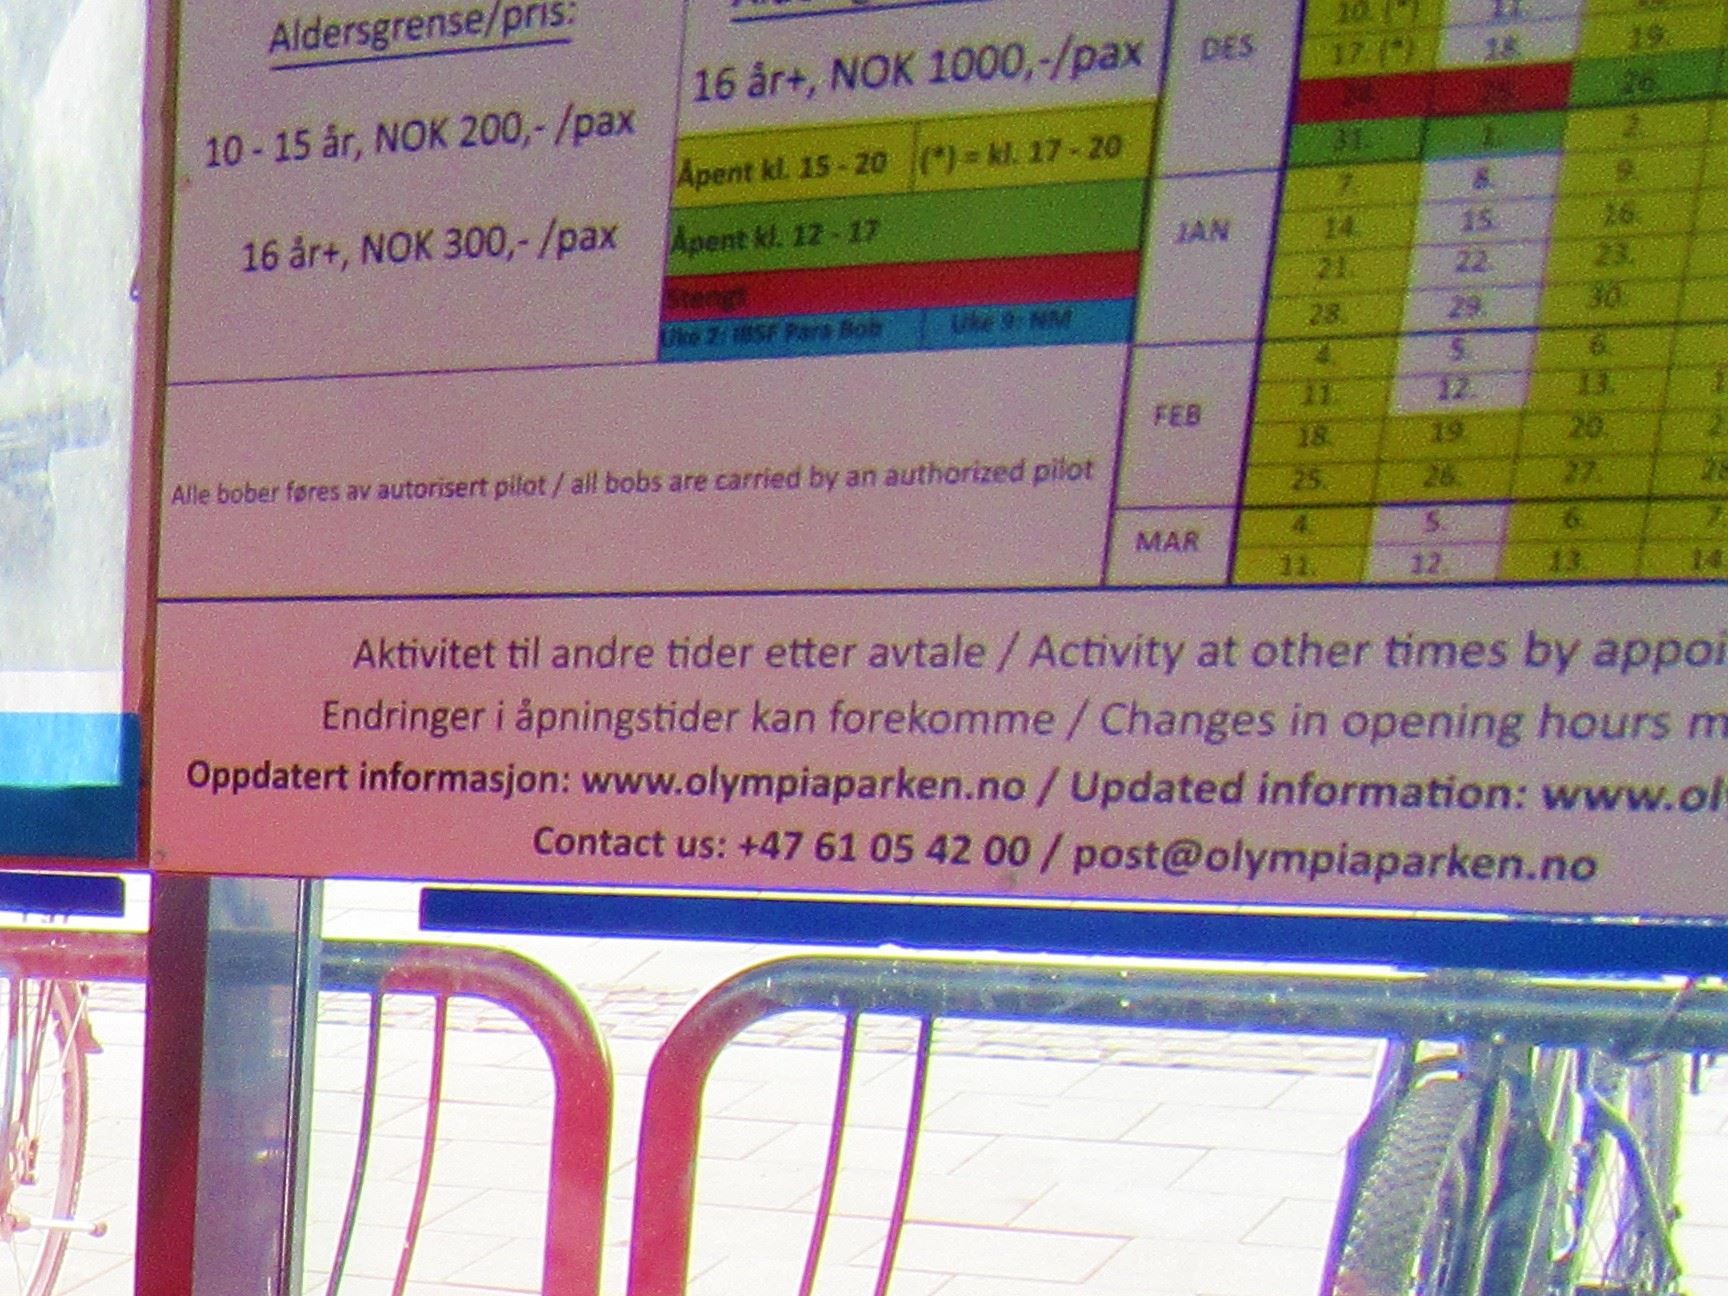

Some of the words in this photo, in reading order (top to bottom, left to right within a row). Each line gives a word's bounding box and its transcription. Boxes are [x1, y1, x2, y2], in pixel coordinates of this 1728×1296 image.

[268, 0, 576, 53] Aldersgrense/pris:
[1200, 35, 1254, 63] DES
[693, 67, 736, 101] 16
[747, 62, 816, 99] år+,
[831, 52, 915, 90] NOK
[928, 34, 1144, 84] 1000,-/pax
[206, 136, 243, 168] 10
[275, 130, 310, 162] 15
[322, 125, 362, 162] år,
[376, 118, 447, 153] NOK
[461, 112, 544, 149] 200,-
[554, 103, 635, 146] /pax
[799, 153, 830, 180] 15
[855, 150, 888, 175] 20
[1029, 140, 1061, 165] 17
[1089, 134, 1123, 160] 20
[243, 241, 278, 272] 16
[289, 236, 348, 272] år+,
[362, 232, 432, 264] NOK
[445, 226, 529, 262] 300,-
[538, 218, 619, 260] /pax
[794, 222, 822, 246] 12
[850, 219, 879, 243] 17
[1176, 219, 1230, 245] JAN
[1155, 404, 1201, 427] FEB
[171, 483, 211, 505] Alle
[218, 480, 280, 503] bober
[286, 480, 340, 503] føres
[347, 484, 372, 502] av
[377, 477, 487, 501] autorisert
[494, 475, 546, 502] pilot
[551, 471, 565, 500] /
[571, 473, 598, 496] all
[605, 471, 662, 495] bobs
[669, 474, 707, 493] are
[714, 465, 802, 492] carried
[809, 464, 840, 492] by
[845, 468, 877, 488] an
[885, 459, 1025, 488] authorized
[1032, 457, 1095, 488] pilot
[1135, 529, 1201, 553] MAR
[353, 637, 496, 669] Aktivitet
[507, 637, 541, 670] til
[551, 636, 654, 670] andre
[667, 636, 754, 670] tider
[765, 636, 857, 670] etter
[868, 632, 986, 670] avtale
[995, 630, 1022, 674] /
[1029, 632, 1187, 676] Activity
[1197, 636, 1238, 670] at
[1251, 632, 1372, 671] other
[1385, 632, 1508, 671] times
[1524, 629, 1580, 676] by
[322, 700, 486, 737] Endringer
[495, 700, 505, 732] i
[515, 697, 740, 738] åpningstider
[752, 699, 816, 734] kan
[828, 698, 1055, 735] forekomme
[1065, 696, 1091, 743] /
[1100, 700, 1275, 746] Changes
[1289, 702, 1327, 739] in
[1343, 702, 1523, 749] opening
[1538, 701, 1671, 741] hours
[187, 758, 349, 796] Oppdatert
[359, 760, 572, 800] informasjon:
[582, 762, 1027, 806] www.olympiaparken.no
[1035, 765, 1061, 811] /
[1070, 770, 1244, 810] Updated
[1257, 773, 1528, 813] information:
[532, 825, 666, 860] Contact
[677, 830, 727, 860] us:
[737, 830, 804, 863] +47
[813, 831, 857, 864] 61
[869, 831, 914, 864] 05
[925, 832, 972, 867] 42
[984, 834, 1030, 867] 00
[1039, 831, 1063, 875] /
[1072, 837, 1598, 884] post@olympiaparken.no
